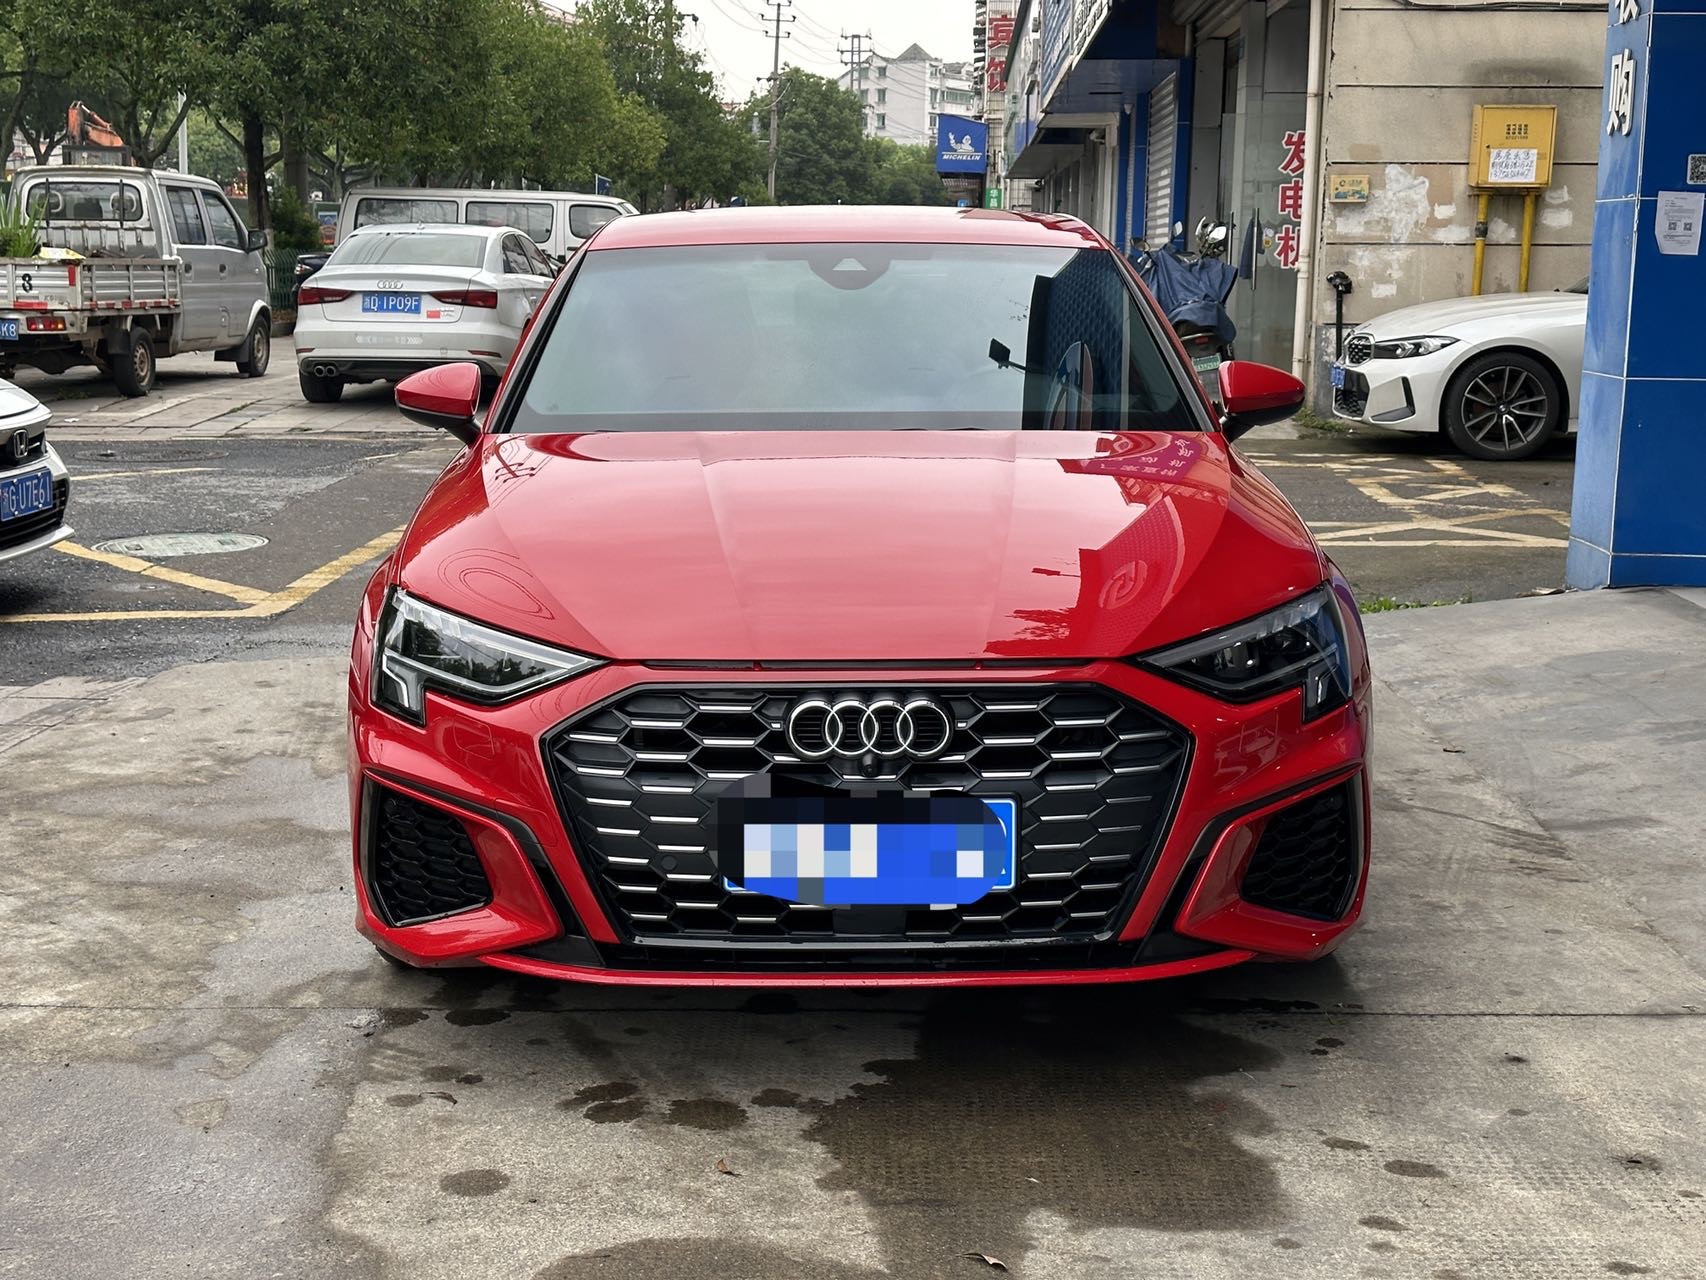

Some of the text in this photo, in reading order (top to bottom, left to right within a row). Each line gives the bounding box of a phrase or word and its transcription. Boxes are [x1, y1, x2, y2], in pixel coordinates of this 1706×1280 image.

[1275, 130, 1306, 269] 发电机
[0, 322, 17, 337] K8
